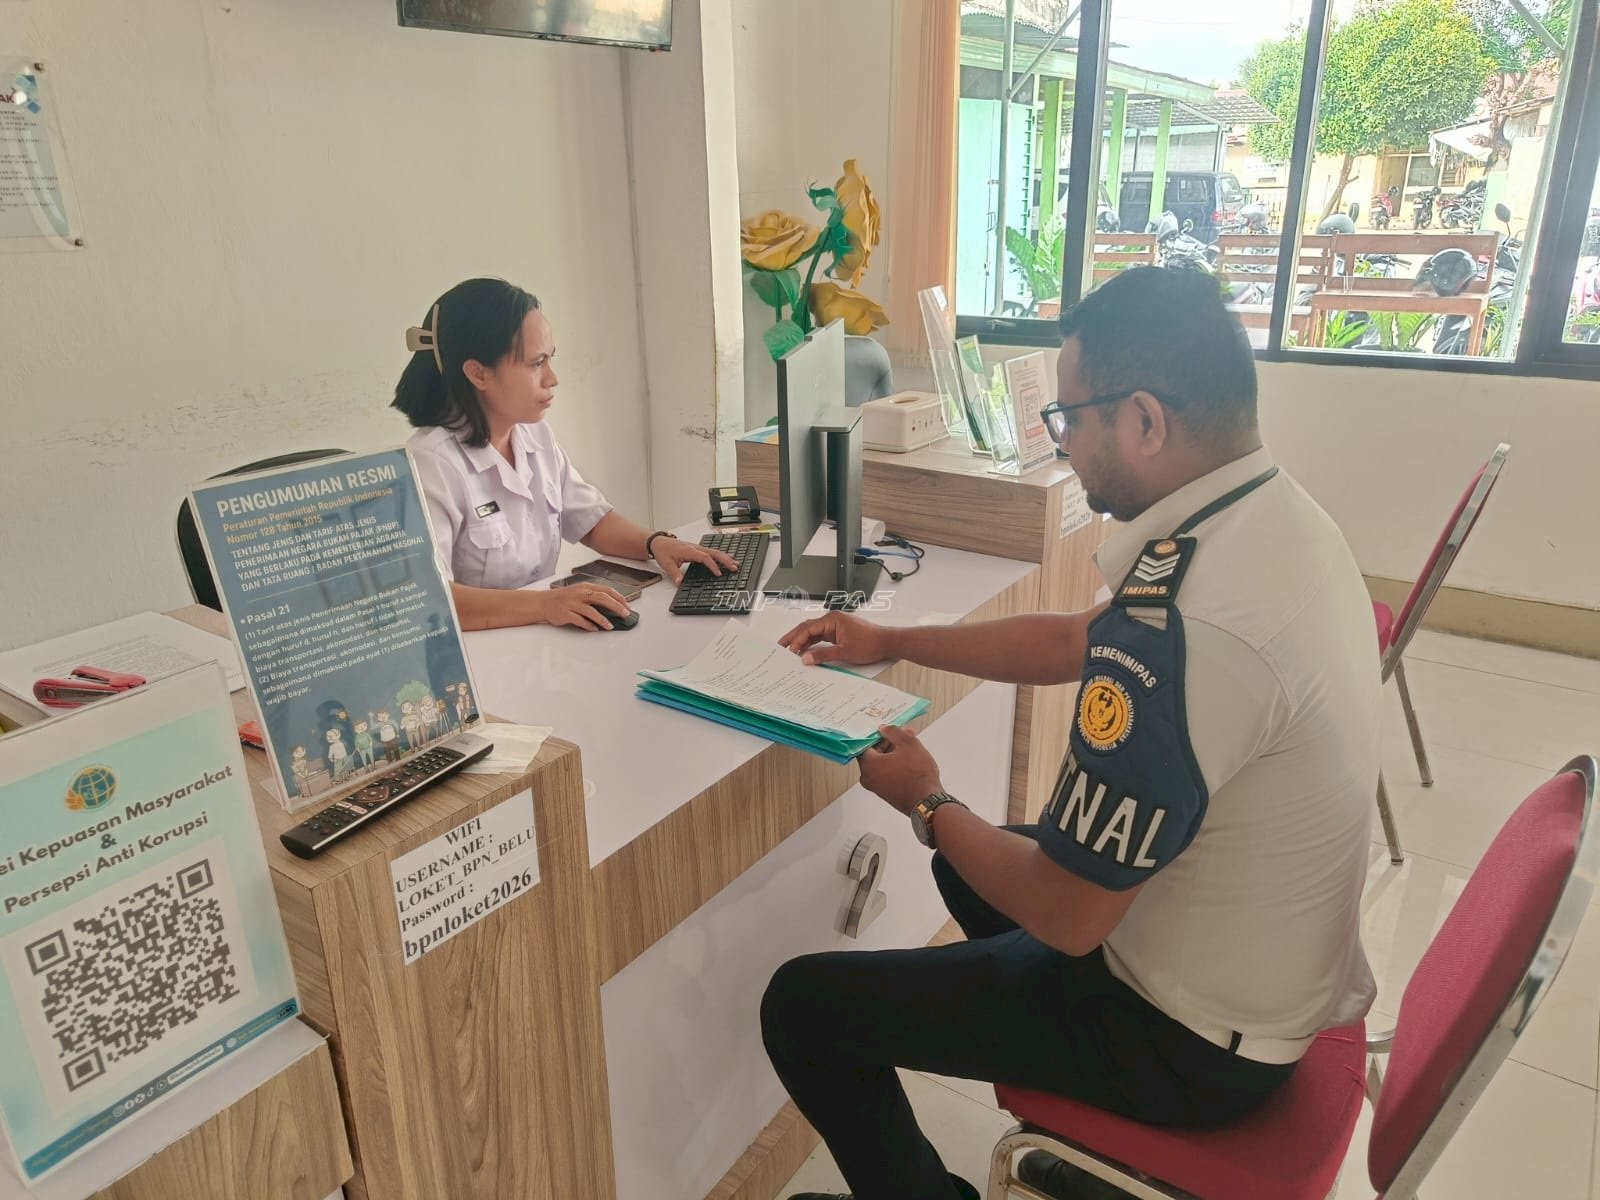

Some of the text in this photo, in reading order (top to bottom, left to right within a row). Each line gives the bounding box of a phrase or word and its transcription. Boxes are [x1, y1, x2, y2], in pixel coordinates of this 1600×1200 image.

[216, 464, 396, 517] PENGUMUMAN RESMI
[223, 486, 393, 532] Peraturan Pemerintah Republik Indonesia
[227, 514, 322, 544] Nomor 128 Tahun 2015
[232, 516, 376, 558] TENTANG JENIS DAN TARIF ATAS JENIS
[235, 549, 289, 569] PENERIMAAN
[290, 541, 322, 554] NEGARA
[323, 534, 349, 546] BUKAN
[350, 527, 374, 539] PAJAK
[238, 530, 406, 580] YANG BERLAKU PADA KEMENTERIAN AGRARIA
[241, 580, 260, 591] DAN
[262, 574, 281, 585] TATA
[282, 566, 310, 580] RUANG
[316, 558, 342, 570] BADAN
[344, 544, 392, 563] PERTANAHAN
[1122, 585, 1168, 595] IMIPAS
[244, 630, 255, 640] (1)
[256, 625, 274, 635] Tarif
[275, 620, 292, 630] atas
[293, 614, 310, 625] jenis
[311, 602, 352, 619] Penerimaan
[246, 603, 290, 624] Pasal 21
[248, 630, 298, 650] sebagaimana
[299, 619, 334, 634] dimaksud
[335, 612, 356, 623] dalam
[252, 648, 280, 661] dengan
[282, 640, 303, 652] huruf
[256, 661, 276, 672] biaya
[312, 661, 347, 677] dimaksud
[1090, 646, 1157, 688] KEMENIMIPAS
[259, 675, 269, 684] (2)
[270, 668, 291, 680] Biaya
[20, 814, 122, 867] Kepuasan
[125, 765, 233, 822] Masyarakat
[445, 817, 482, 846] WIFI
[4, 811, 209, 914] Persepsi Anti Korupsi
[100, 833, 117, 850] &
[396, 835, 485, 893] USERNAME
[399, 825, 535, 914] LOKET_BPN_BELU
[845, 831, 888, 939] 2
[401, 885, 465, 932] Password
[404, 867, 532, 959] bpnloket2026
